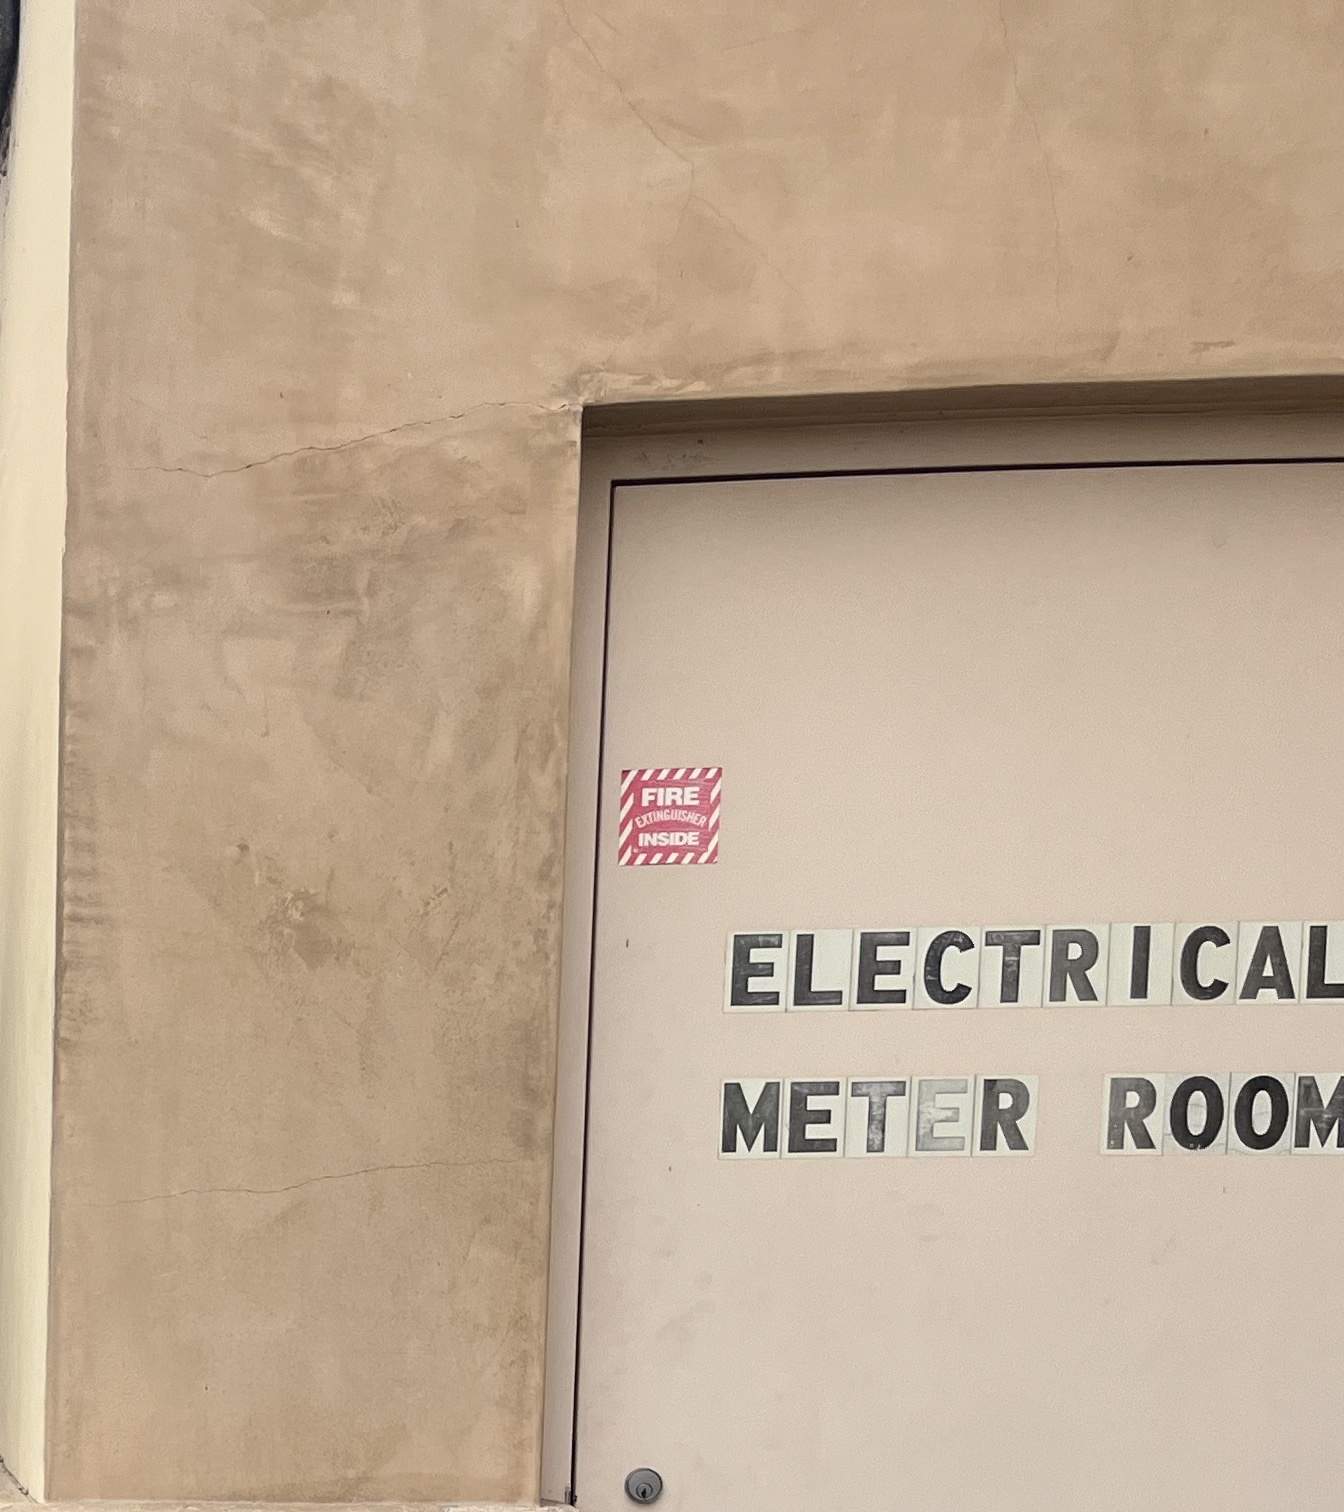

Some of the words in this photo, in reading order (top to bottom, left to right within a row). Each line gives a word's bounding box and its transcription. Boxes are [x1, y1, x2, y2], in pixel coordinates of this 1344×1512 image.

[641, 786, 700, 807] FIRE
[635, 809, 707, 829] EXTINGUISHER
[638, 832, 700, 847] INSIDE
[729, 924, 1344, 1006] ELECTRICAL
[720, 1077, 1031, 1153] METER
[1106, 1073, 1344, 1151] ROOM
